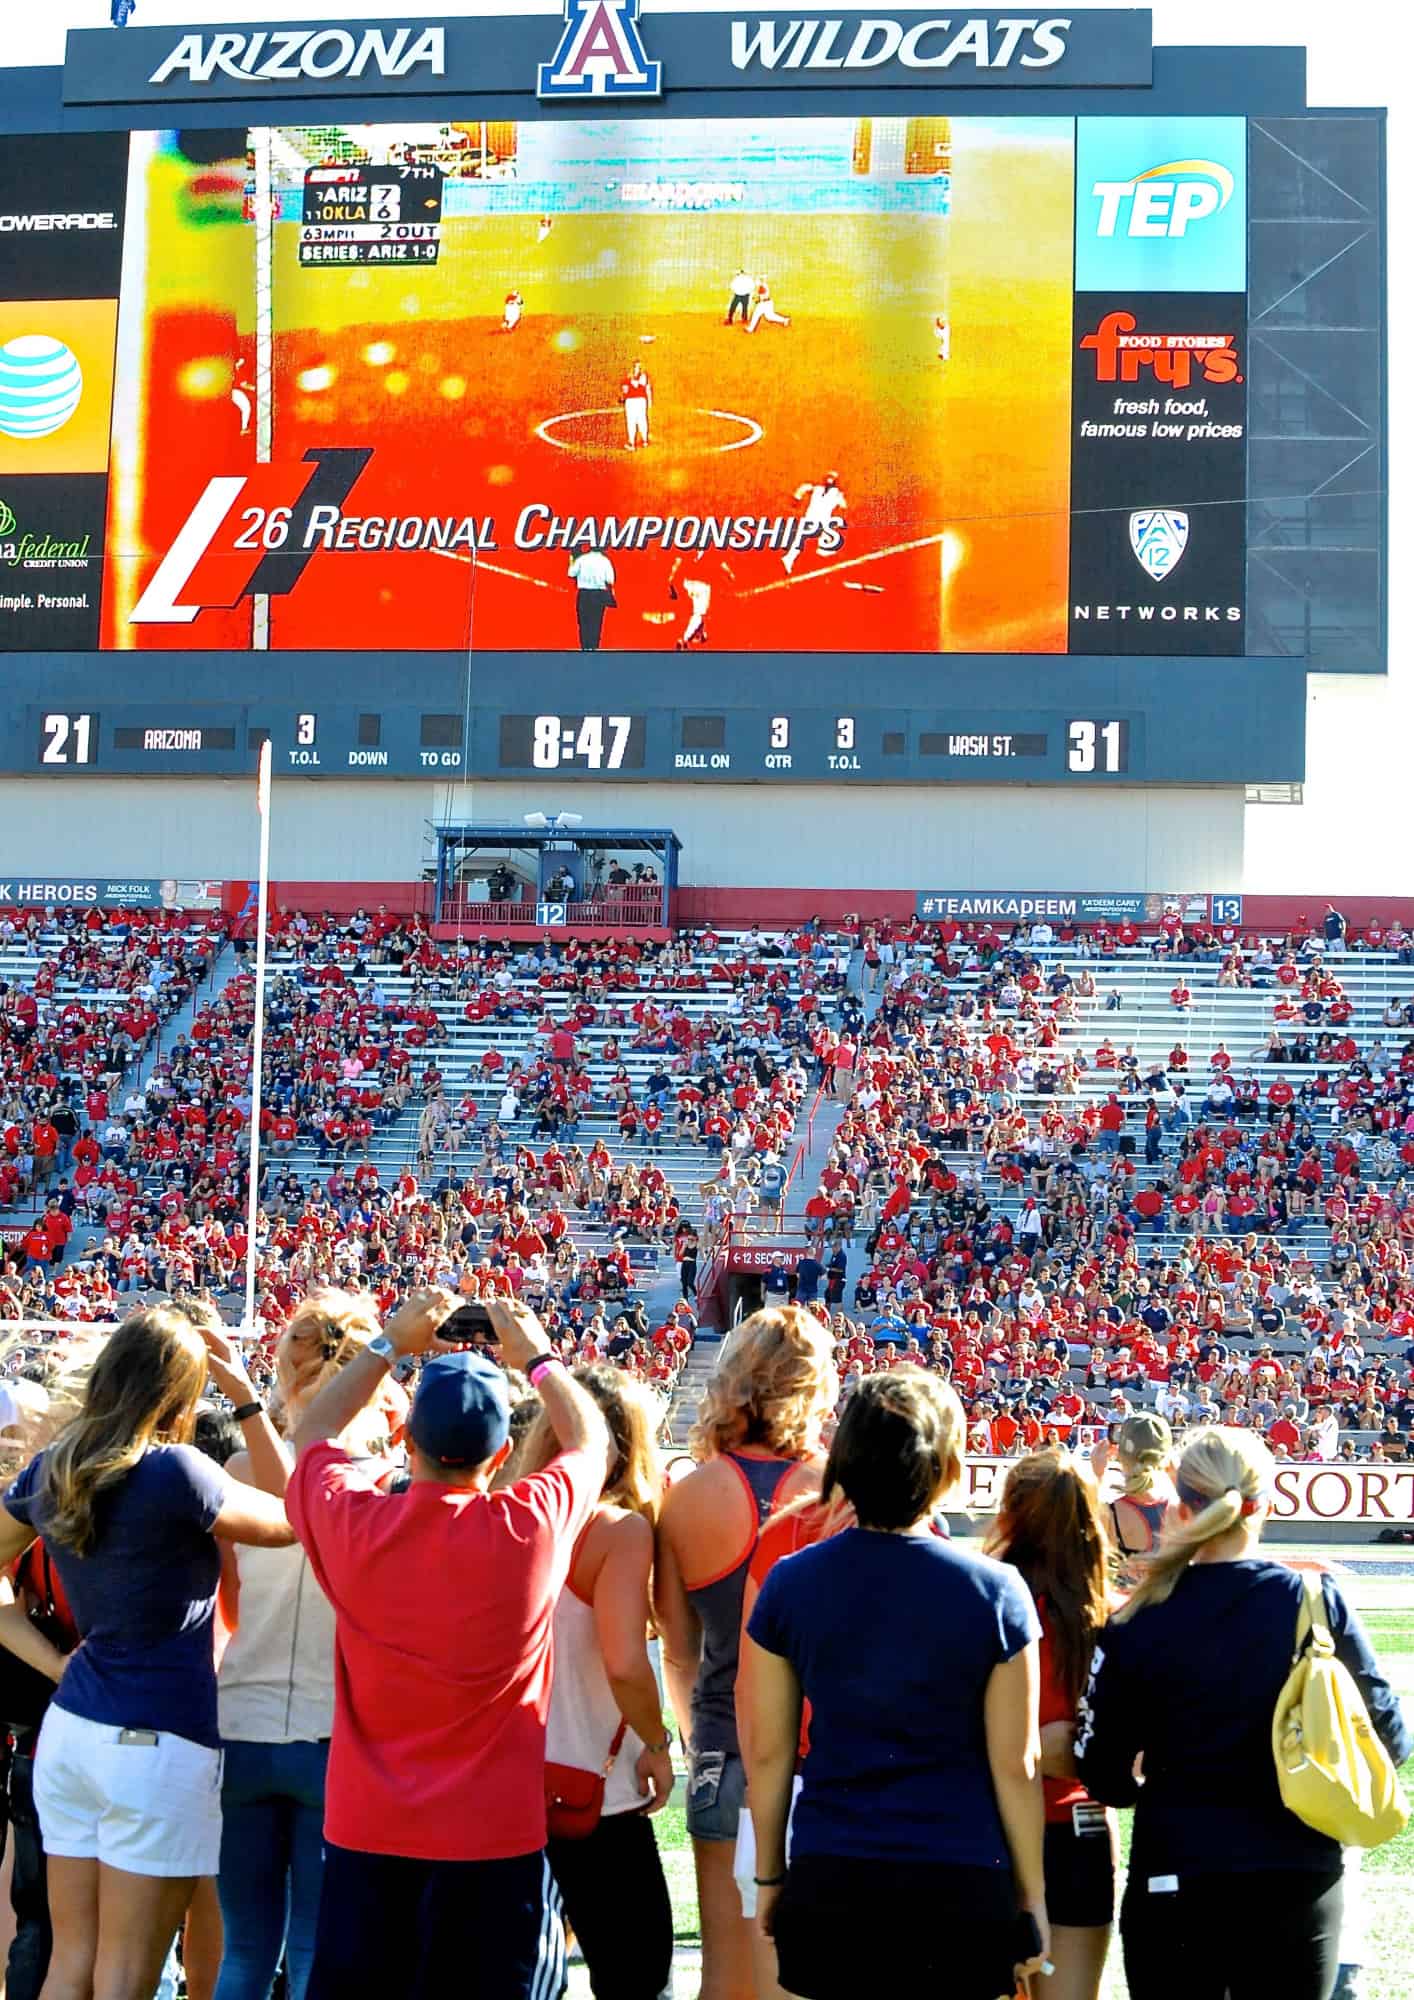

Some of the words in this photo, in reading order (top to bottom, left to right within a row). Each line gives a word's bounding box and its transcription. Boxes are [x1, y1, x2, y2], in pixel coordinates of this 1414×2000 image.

[731, 18, 1072, 70] WILDCATS
[148, 27, 446, 83] ARIZONA
[381, 188, 392, 200] 7
[377, 205, 391, 219] 6
[1092, 181, 1219, 238] TEP
[396, 225, 437, 238] OUT
[368, 244, 407, 259] ARIZ
[1118, 336, 1162, 348] FOOD
[1166, 336, 1227, 348] STORES
[1113, 398, 1160, 415] fresh
[1163, 398, 1209, 418] food,
[1080, 421, 1147, 438] famous
[1151, 421, 1184, 438] low
[1186, 422, 1243, 442] prices
[233, 507, 292, 549] 26
[303, 504, 497, 550] REGIONAL
[514, 503, 848, 551] CHAMPIONSHIPS
[58, 559, 88, 568] UNION
[1148, 547, 1169, 567] 12
[37, 593, 90, 609] Personal.
[1074, 606, 1242, 620] NETWORKS
[43, 714, 91, 763] 21
[298, 714, 315, 745] 3
[771, 717, 789, 749] 3
[837, 718, 854, 749] 3
[144, 730, 202, 750] ARIZONA
[532, 715, 631, 769] 8:47
[949, 735, 989, 757] WASH
[992, 735, 1016, 757] ST.
[1068, 721, 1120, 772] 31
[289, 751, 321, 765] T.O.L
[348, 752, 388, 766] DOWN
[420, 753, 439, 766] TO
[441, 753, 461, 766] GO
[675, 754, 708, 768] BALL
[710, 754, 730, 768] ON
[765, 754, 792, 769] QTR
[828, 755, 861, 769] T.O.L
[18, 884, 97, 901] HEROES
[538, 904, 564, 924] 12
[922, 898, 1076, 915] #TEAMKADEEM
[1213, 900, 1240, 919] 13
[743, 1253, 752, 1264] 12
